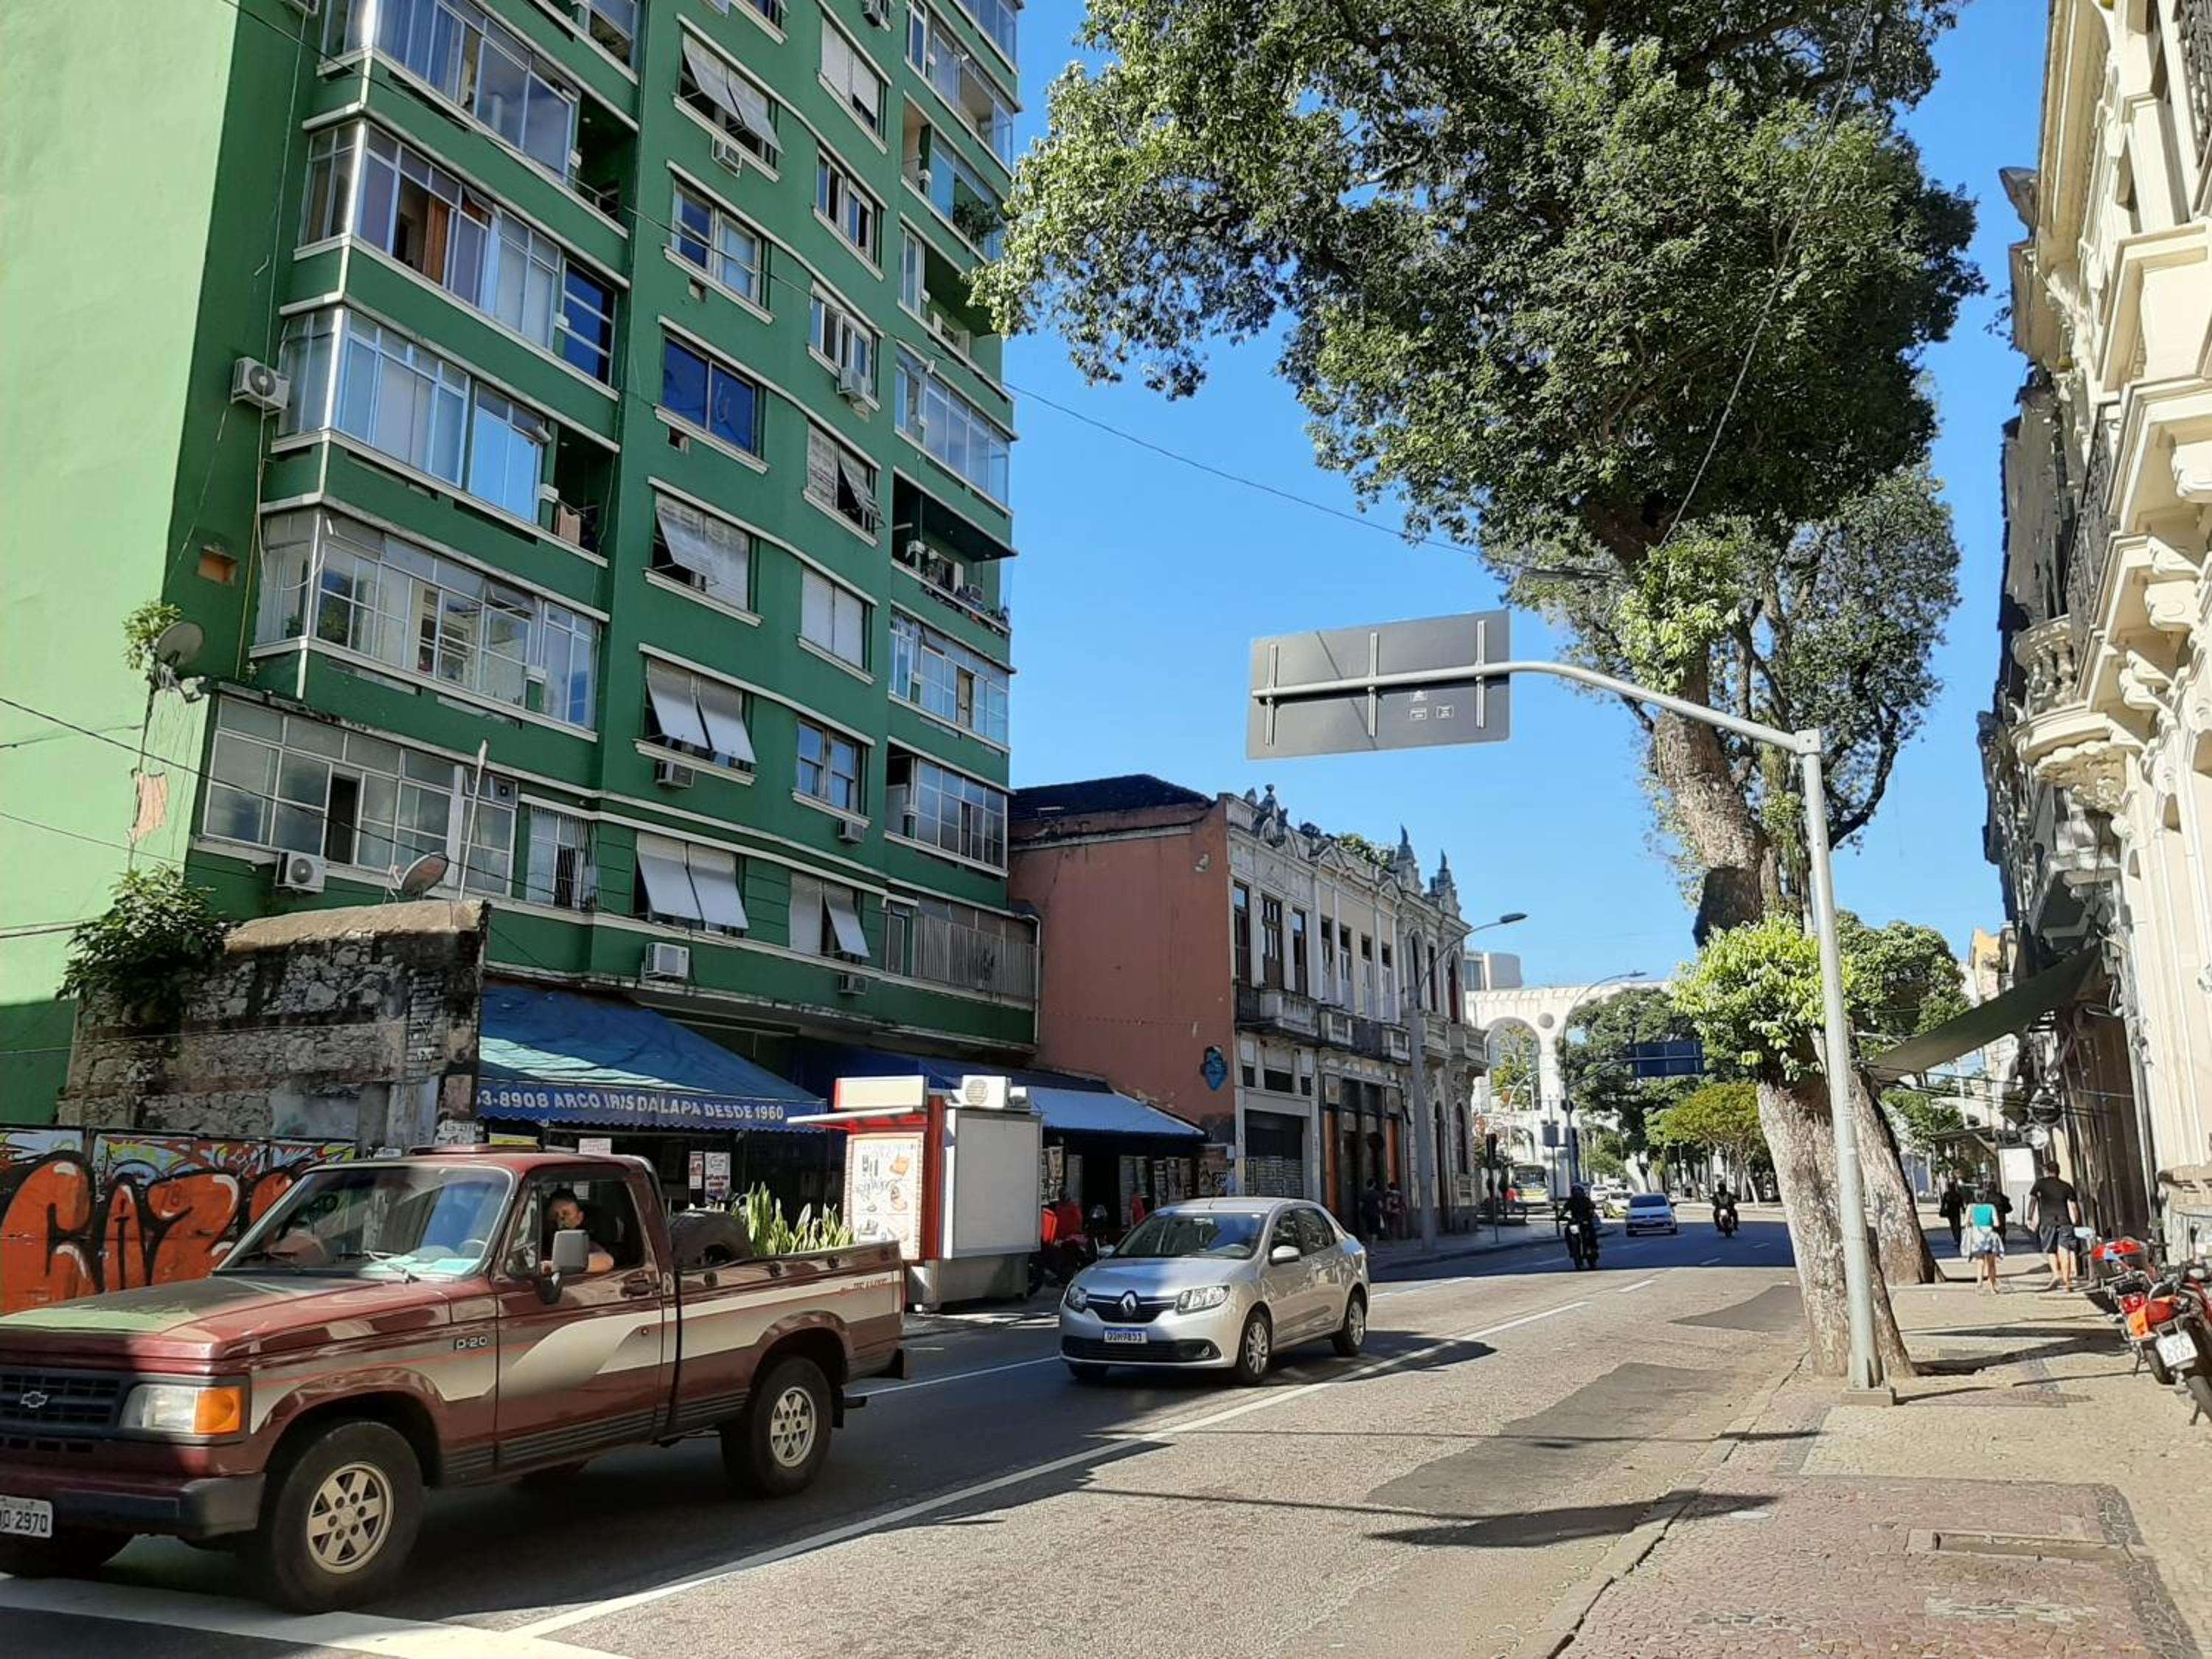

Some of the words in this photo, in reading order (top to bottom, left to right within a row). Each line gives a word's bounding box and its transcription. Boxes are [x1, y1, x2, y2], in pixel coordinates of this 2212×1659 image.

[476, 1090, 549, 1109] 3-8908
[554, 1093, 600, 1109] ARCO
[604, 1093, 634, 1111] IRIS
[637, 1095, 659, 1112] DA
[659, 1097, 701, 1116] LAPA
[703, 1102, 753, 1119] DESDE
[754, 1105, 785, 1120] 1960
[456, 1336, 487, 1349] D-20
